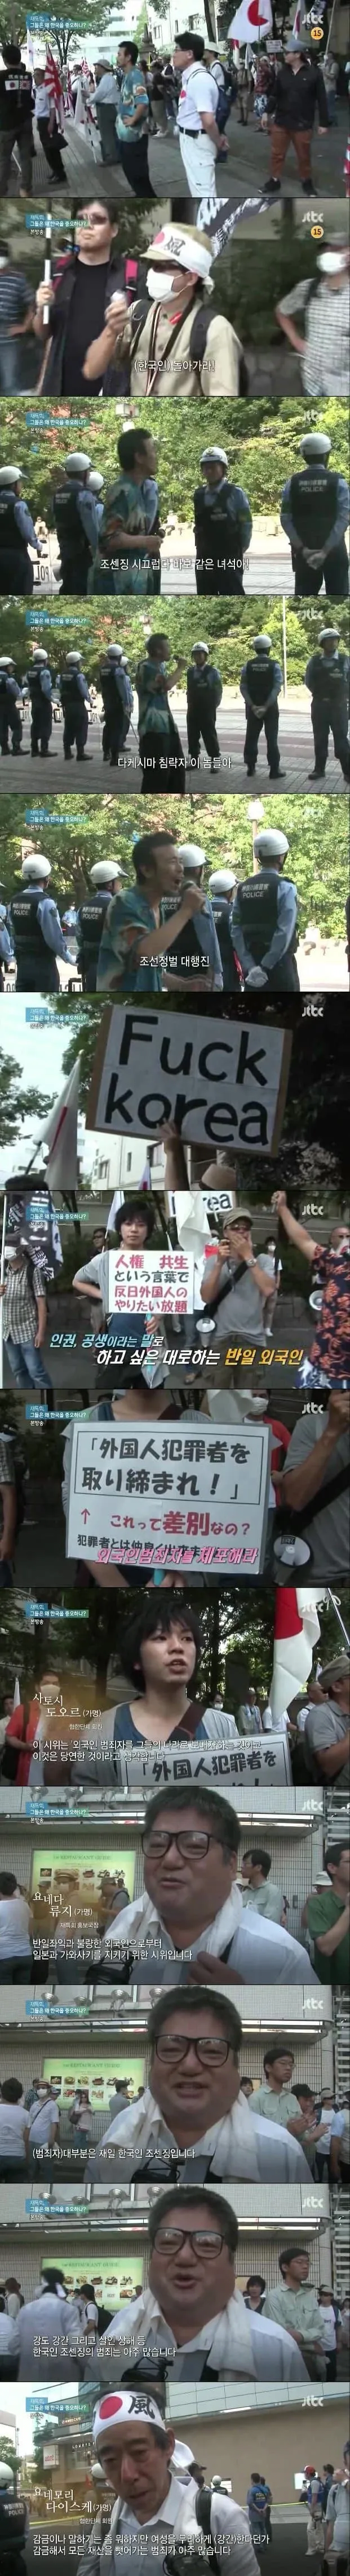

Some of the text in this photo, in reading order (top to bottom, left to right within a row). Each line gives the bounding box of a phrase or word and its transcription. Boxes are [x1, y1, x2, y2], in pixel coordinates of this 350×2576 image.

[118, 1014, 268, 1086] Fuck
[105, 1073, 268, 1146] korea
[115, 1254, 189, 1269] 人権 共生
[114, 1270, 189, 1283] という言葉で
[115, 1285, 187, 1298] 反日外国人の
[115, 1300, 188, 1313] やりたい放題
[92, 1438, 250, 1464] 「外国人犯罪者を
[143, 1751, 276, 1782] 「外国人犯罪者を
[128, 2395, 155, 2419] 風
